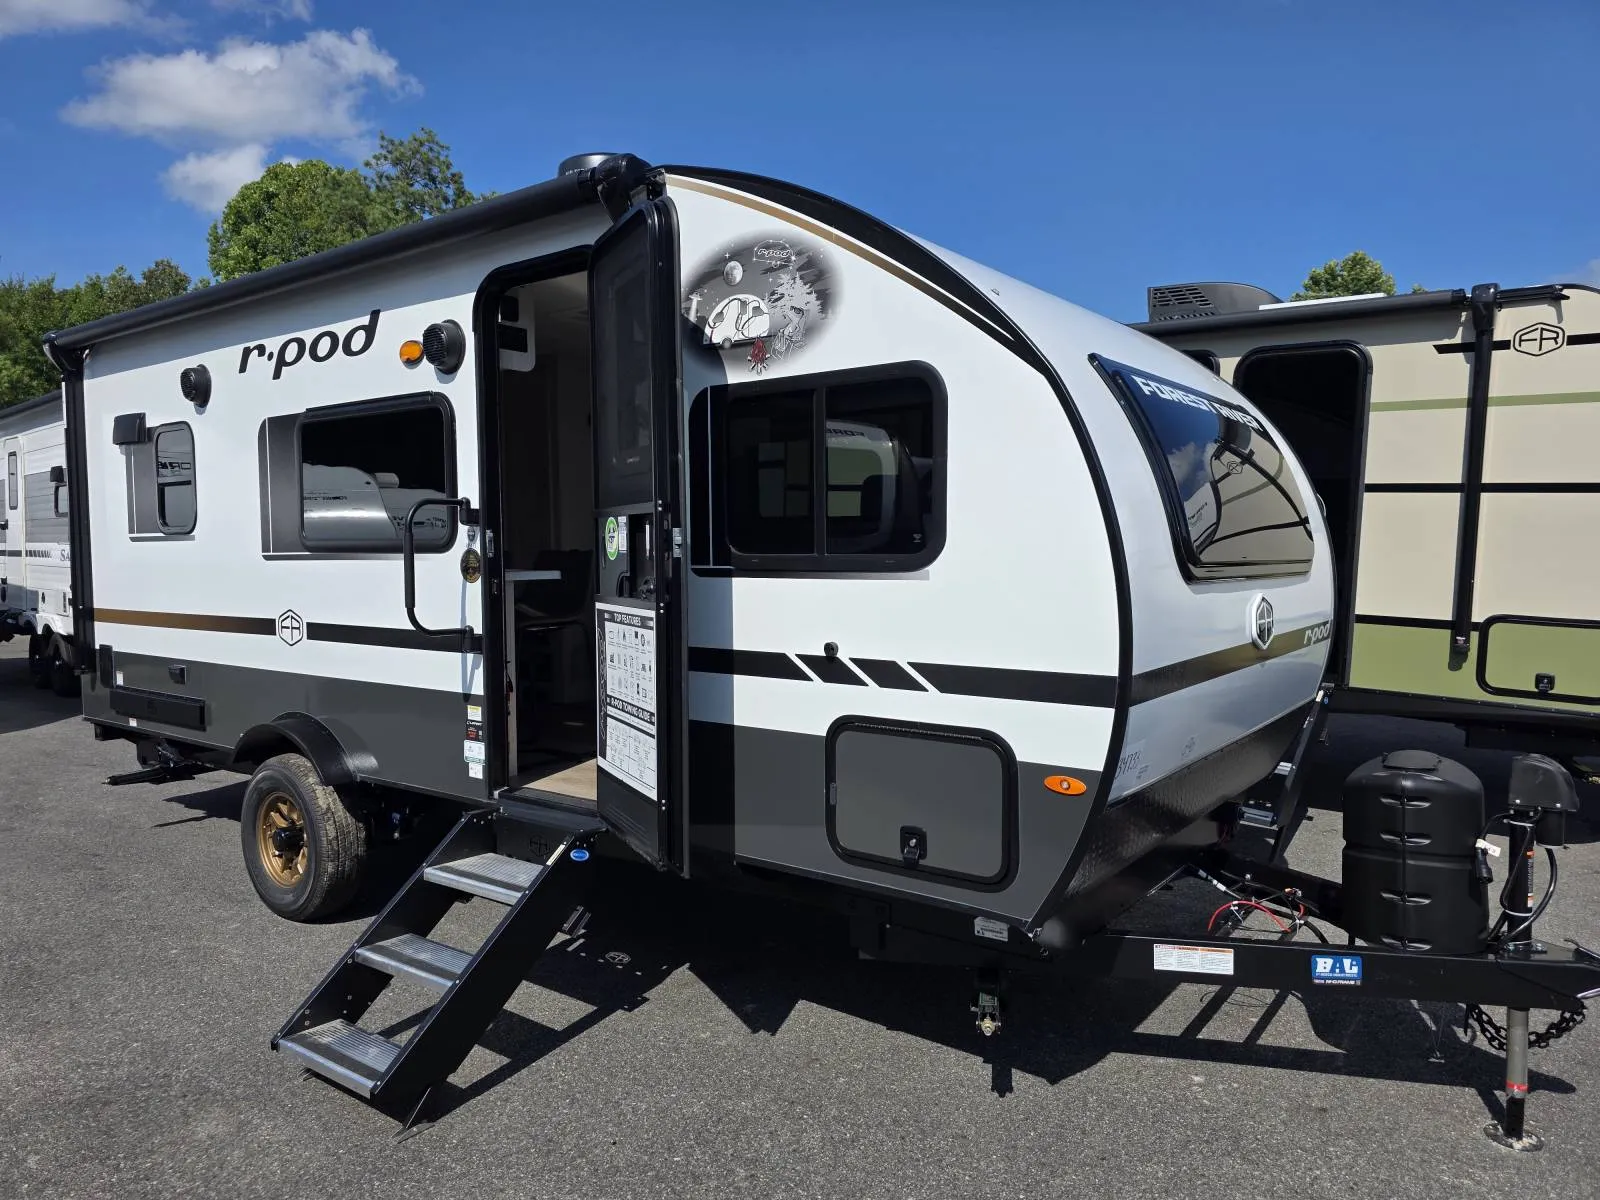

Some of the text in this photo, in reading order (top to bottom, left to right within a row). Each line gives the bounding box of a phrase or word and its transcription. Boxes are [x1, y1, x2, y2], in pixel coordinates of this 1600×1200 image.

[1131, 375, 1263, 432] FOREST RIVER
[1315, 957, 1359, 974] BAL
